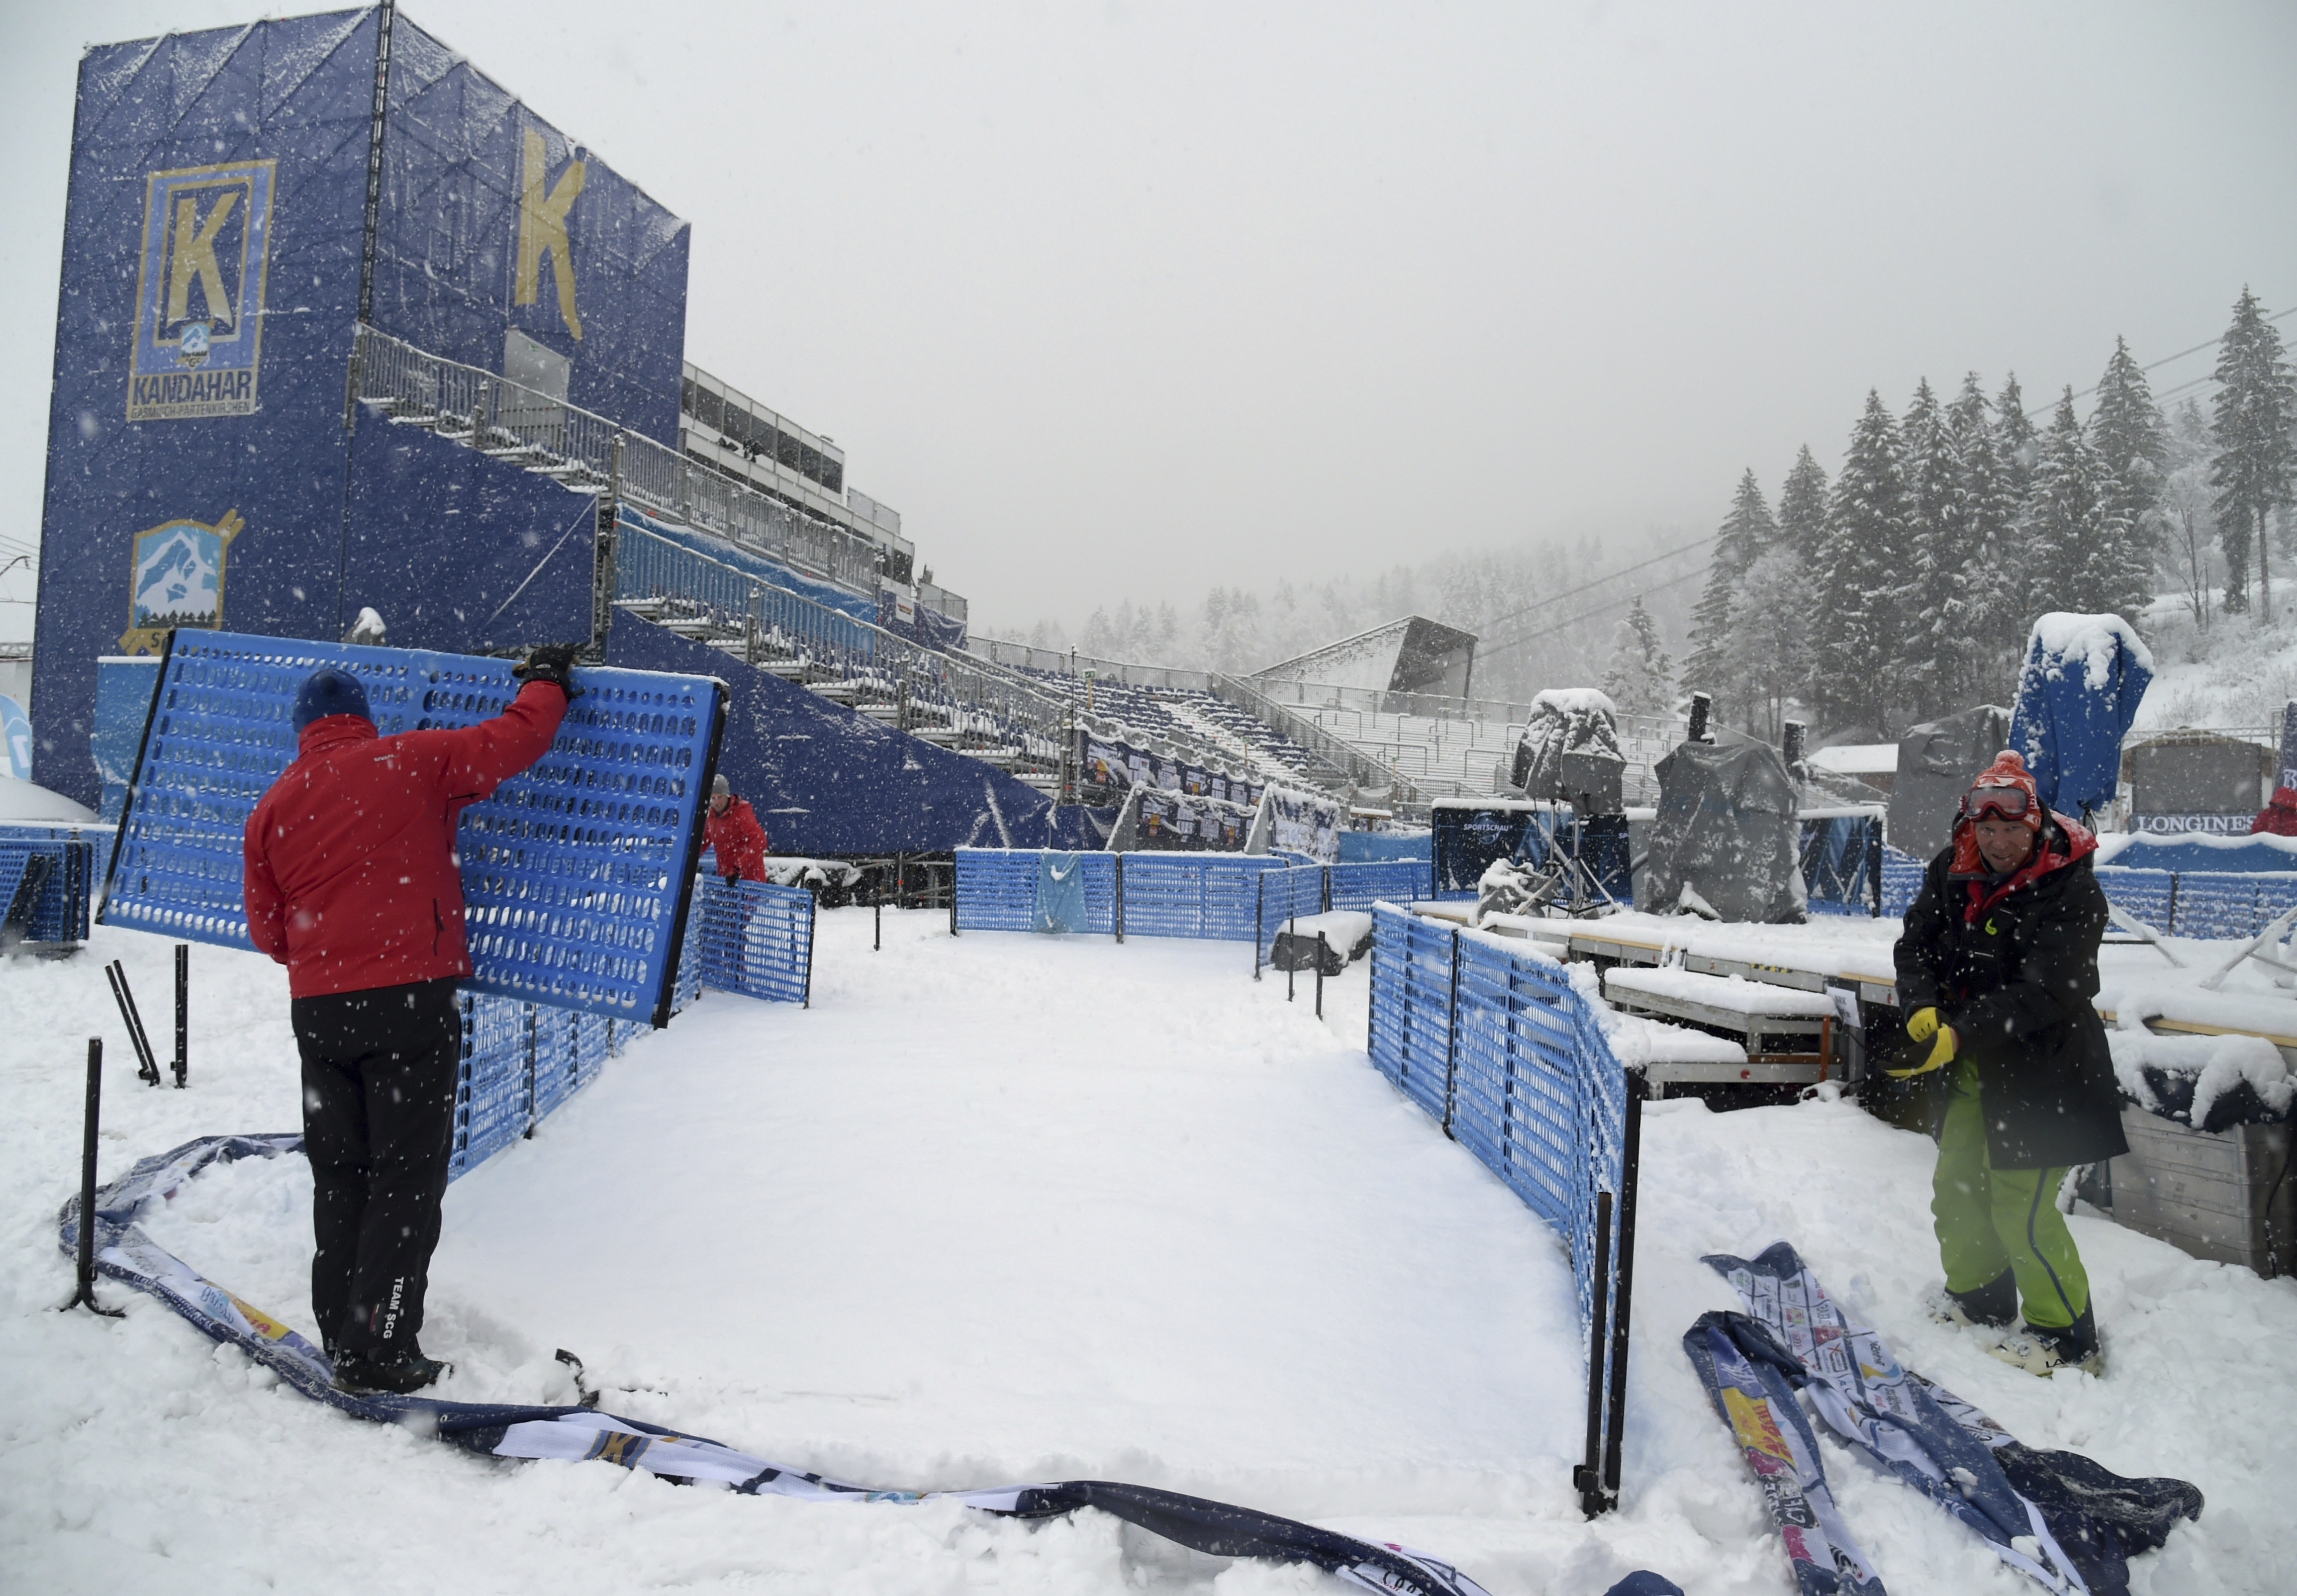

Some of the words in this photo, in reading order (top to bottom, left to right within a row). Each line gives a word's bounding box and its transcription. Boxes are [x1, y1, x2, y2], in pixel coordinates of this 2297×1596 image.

[515, 126, 586, 341] K
[166, 192, 240, 328] K
[133, 371, 252, 406] KANDAHAR
[389, 1276, 404, 1311] TEAM
[383, 1313, 396, 1339] SCG
